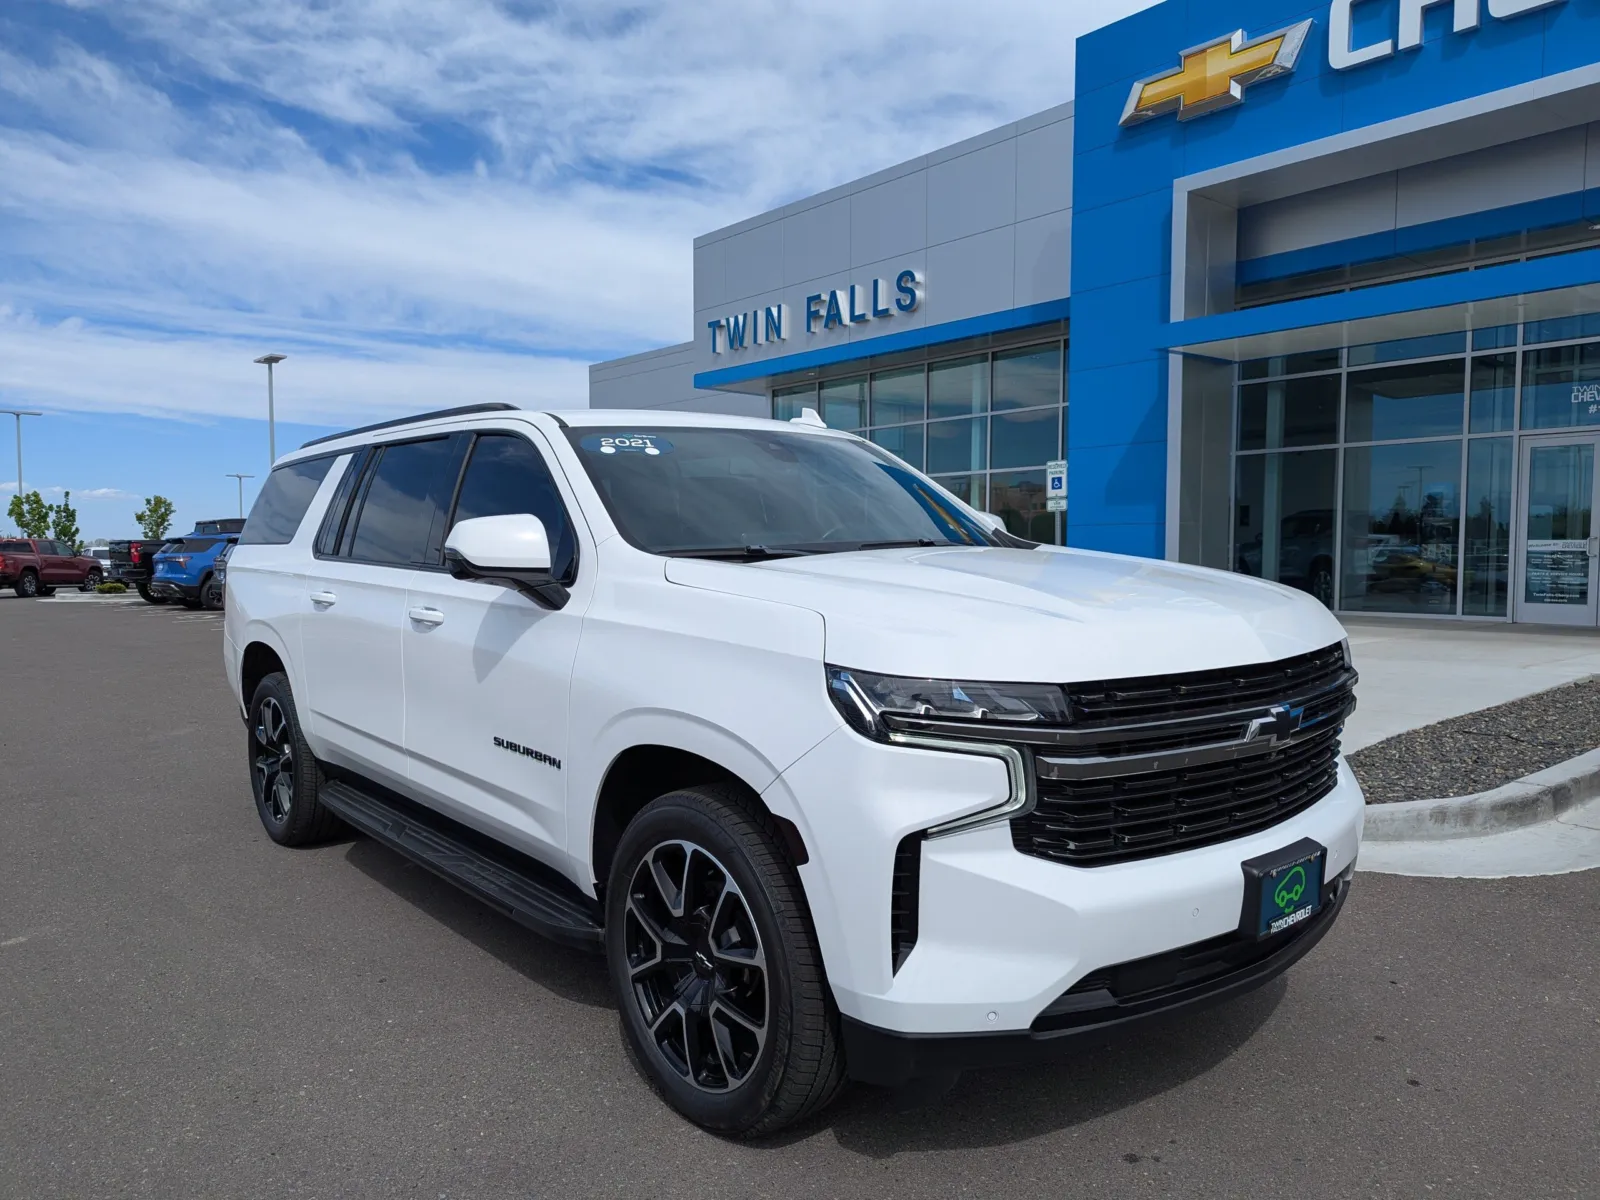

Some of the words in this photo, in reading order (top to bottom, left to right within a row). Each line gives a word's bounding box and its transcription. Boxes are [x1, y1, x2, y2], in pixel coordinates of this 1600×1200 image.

[708, 304, 786, 354] TWIN
[806, 270, 921, 333] FALLS
[600, 438, 655, 448] 2021
[493, 736, 561, 770] SUBURBAN
